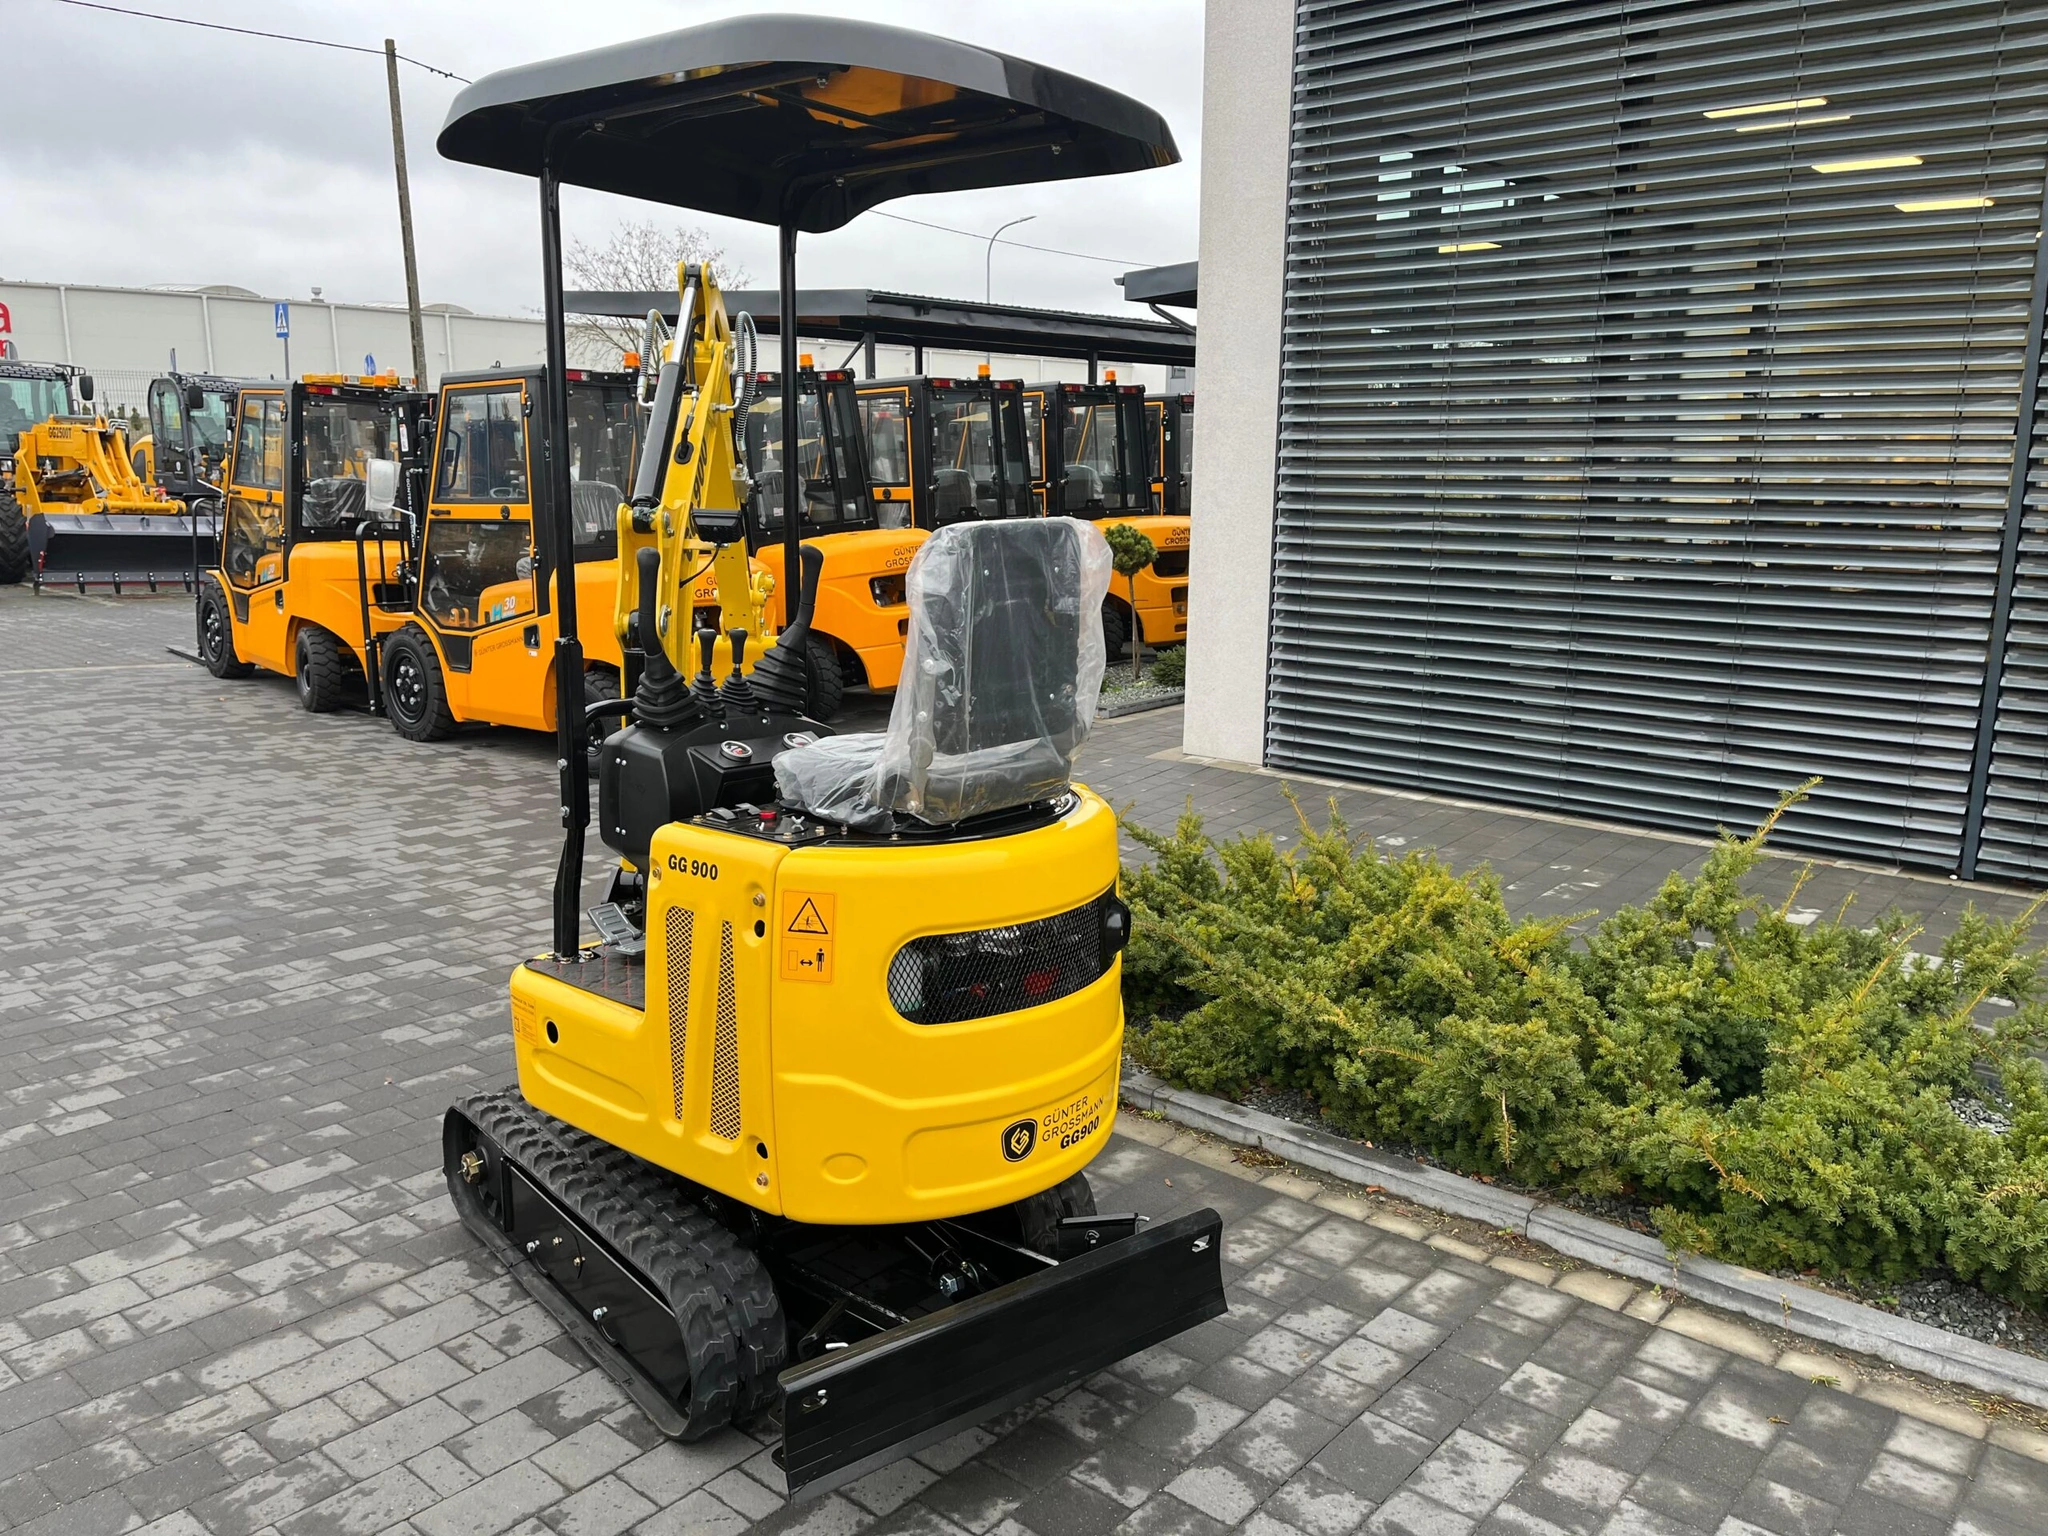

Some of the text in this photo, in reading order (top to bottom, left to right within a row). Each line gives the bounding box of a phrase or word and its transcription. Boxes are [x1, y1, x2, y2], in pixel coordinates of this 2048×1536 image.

[504, 596, 516, 611] 30
[668, 854, 718, 880] GG 900
[1042, 1095, 1104, 1142] GROSSMANN
[1043, 1096, 1088, 1127] GÜNTER
[1060, 1116, 1100, 1150] GG900
